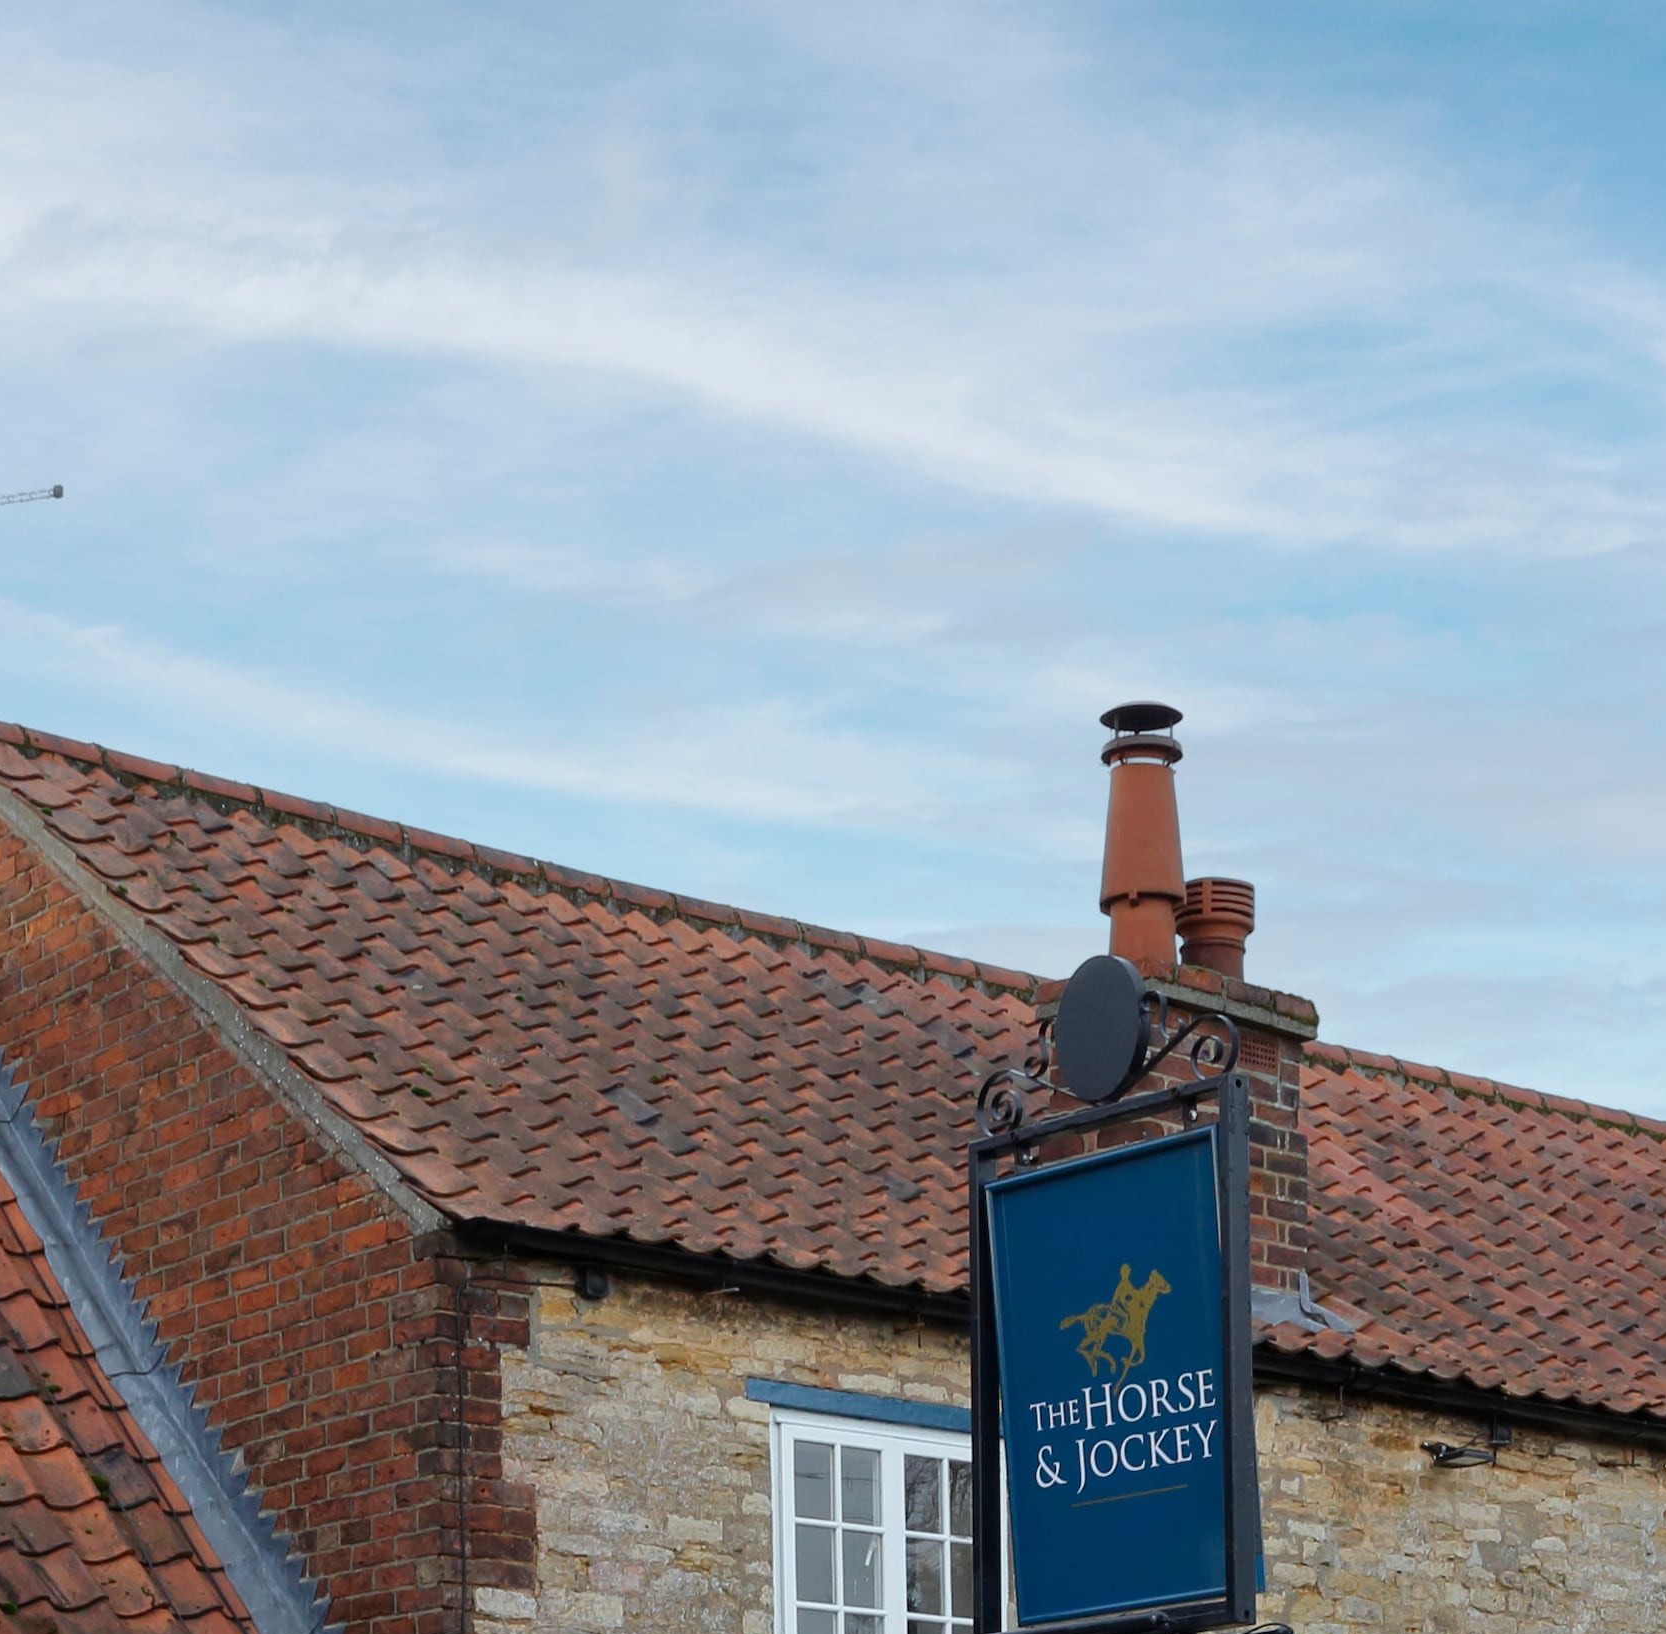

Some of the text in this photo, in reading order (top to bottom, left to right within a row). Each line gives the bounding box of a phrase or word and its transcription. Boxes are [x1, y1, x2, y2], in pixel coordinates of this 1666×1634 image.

[1029, 1368, 1216, 1431] THE HORSE
[1035, 1419, 1217, 1494] & JOCKEY
